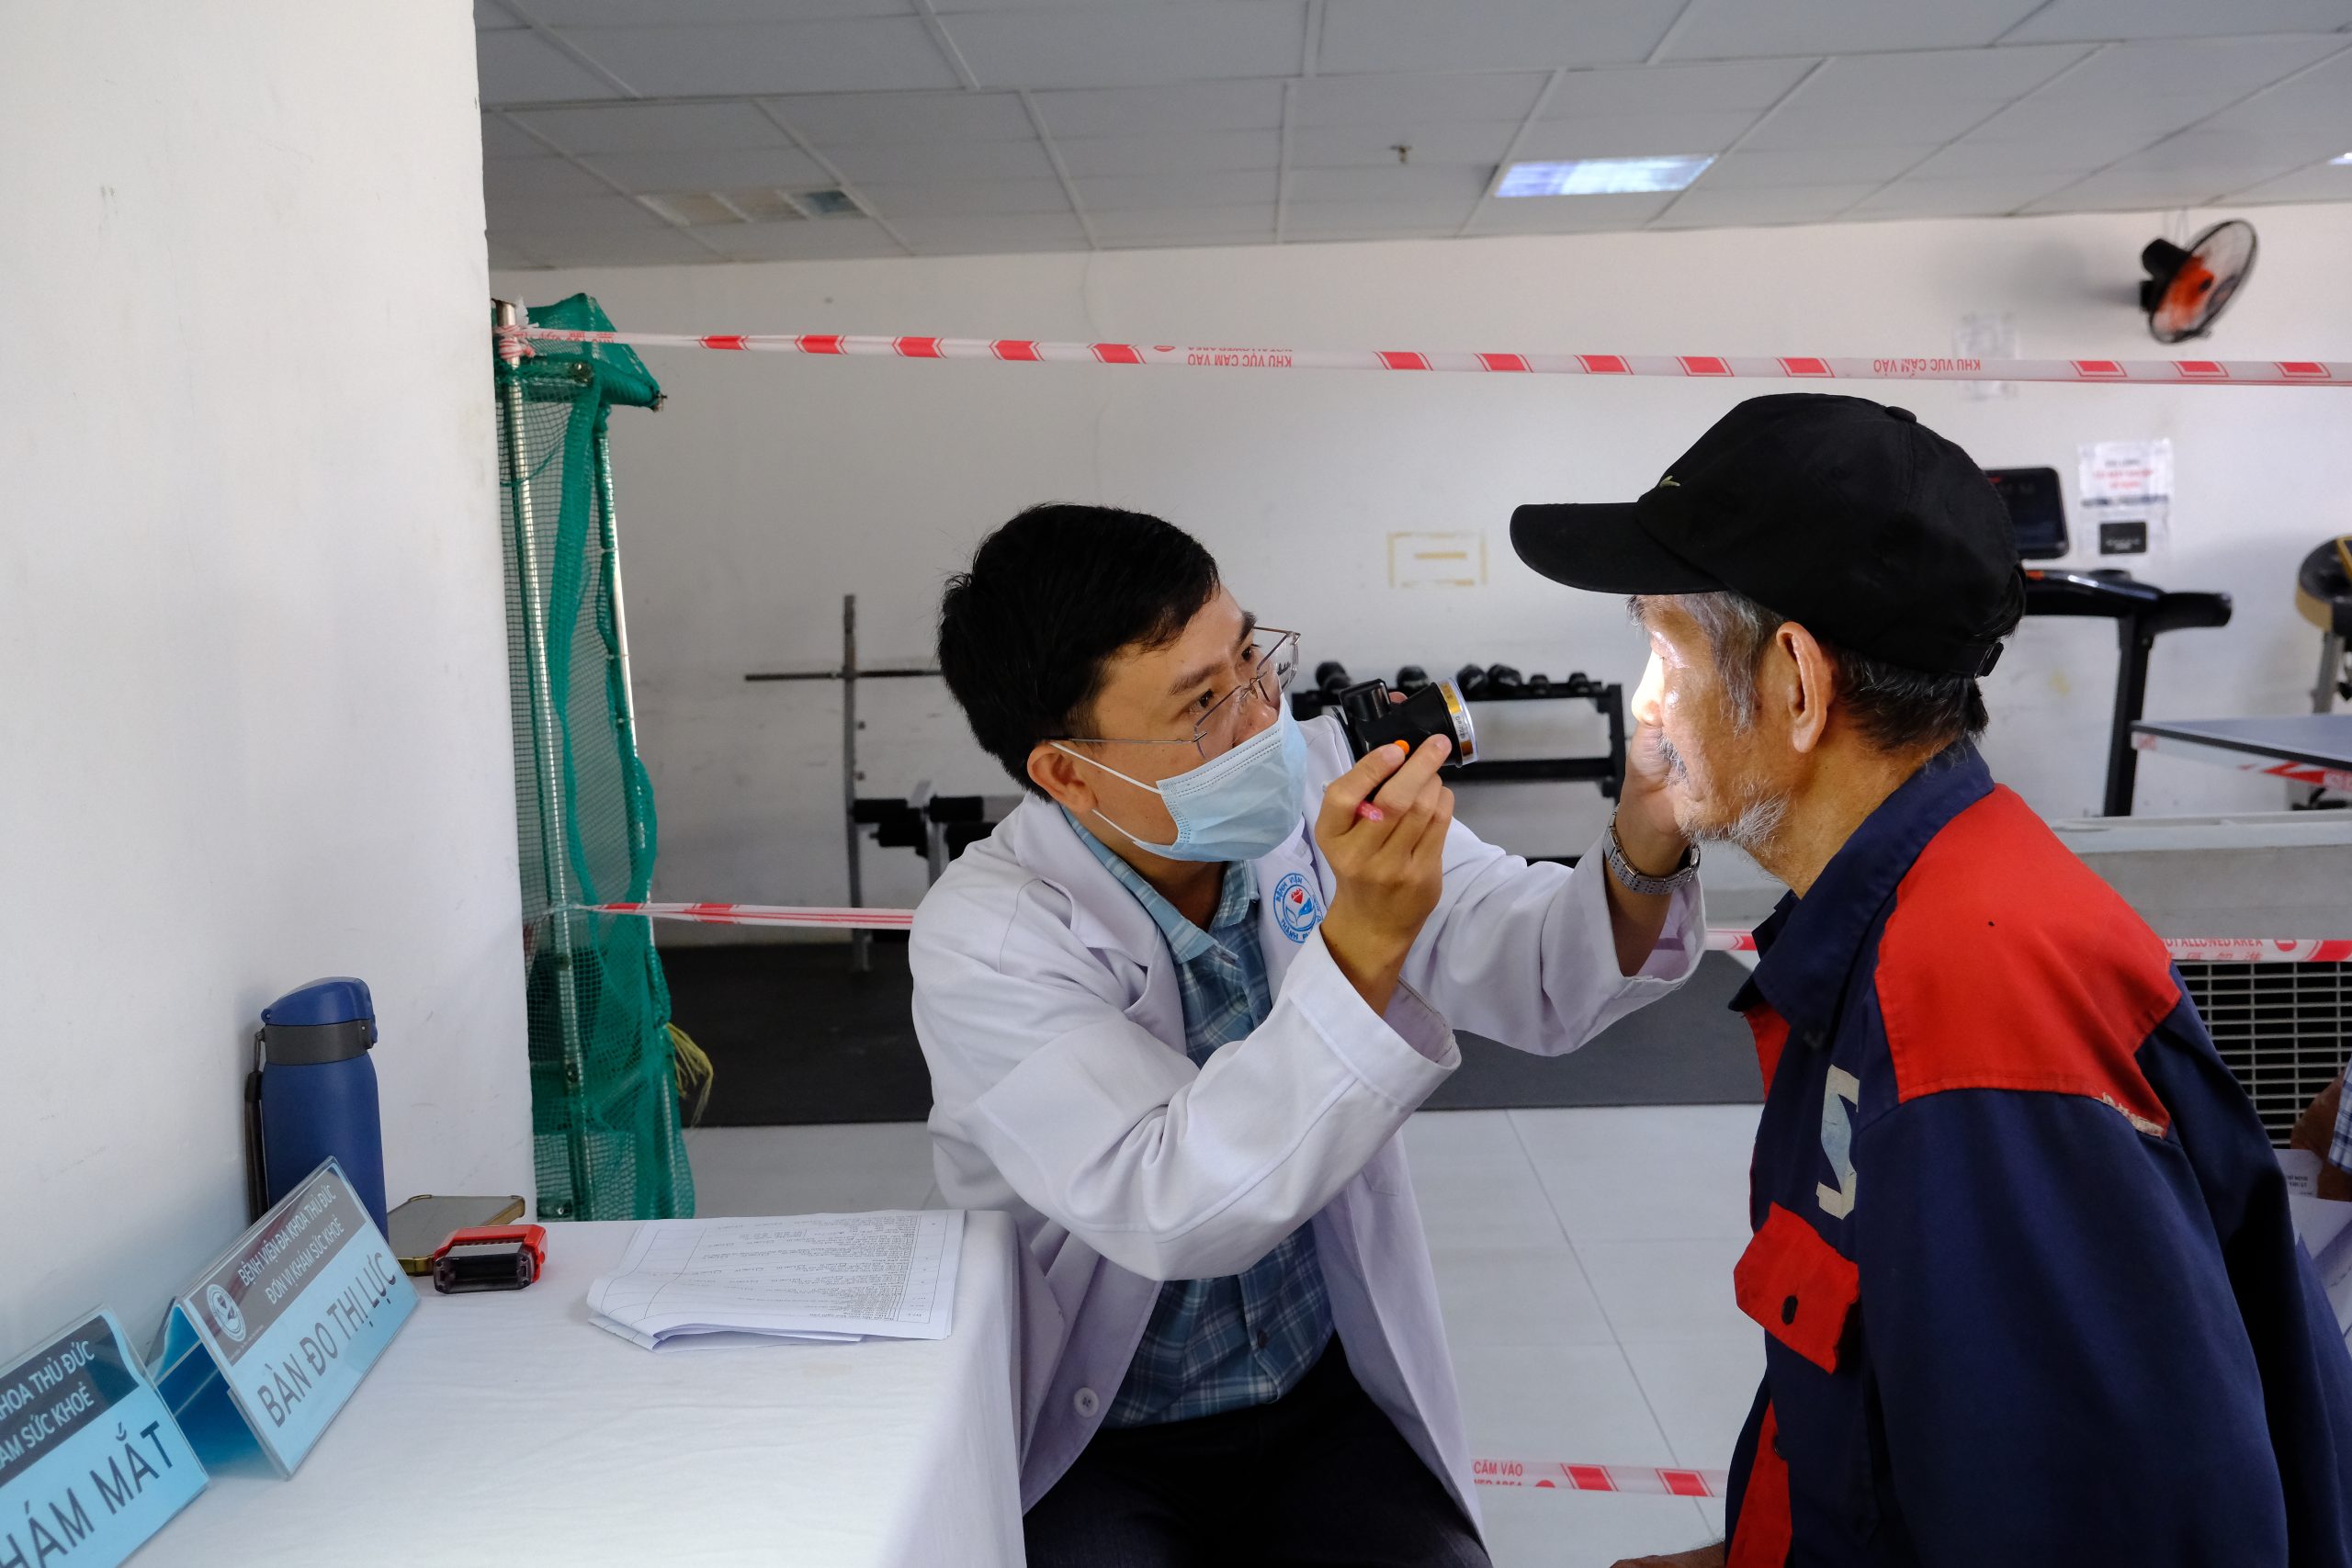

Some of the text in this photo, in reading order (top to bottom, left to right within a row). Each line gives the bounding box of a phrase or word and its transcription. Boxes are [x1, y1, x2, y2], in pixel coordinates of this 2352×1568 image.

[1268, 353, 1292, 367] KHU
[1957, 358, 1981, 371] KHU
[238, 1184, 337, 1287] BỆNH VIỆN ĐA KHOA THỦ ĐỨC
[288, 1248, 316, 1280] KHÁM
[309, 1233, 329, 1259] SỨC
[257, 1251, 397, 1427] BÀN ĐO THỊ LỰC
[28, 1356, 64, 1394] THỦ
[61, 1340, 96, 1375] ĐỨC
[21, 1414, 56, 1450] SỨC
[89, 1420, 174, 1516] MẮT
